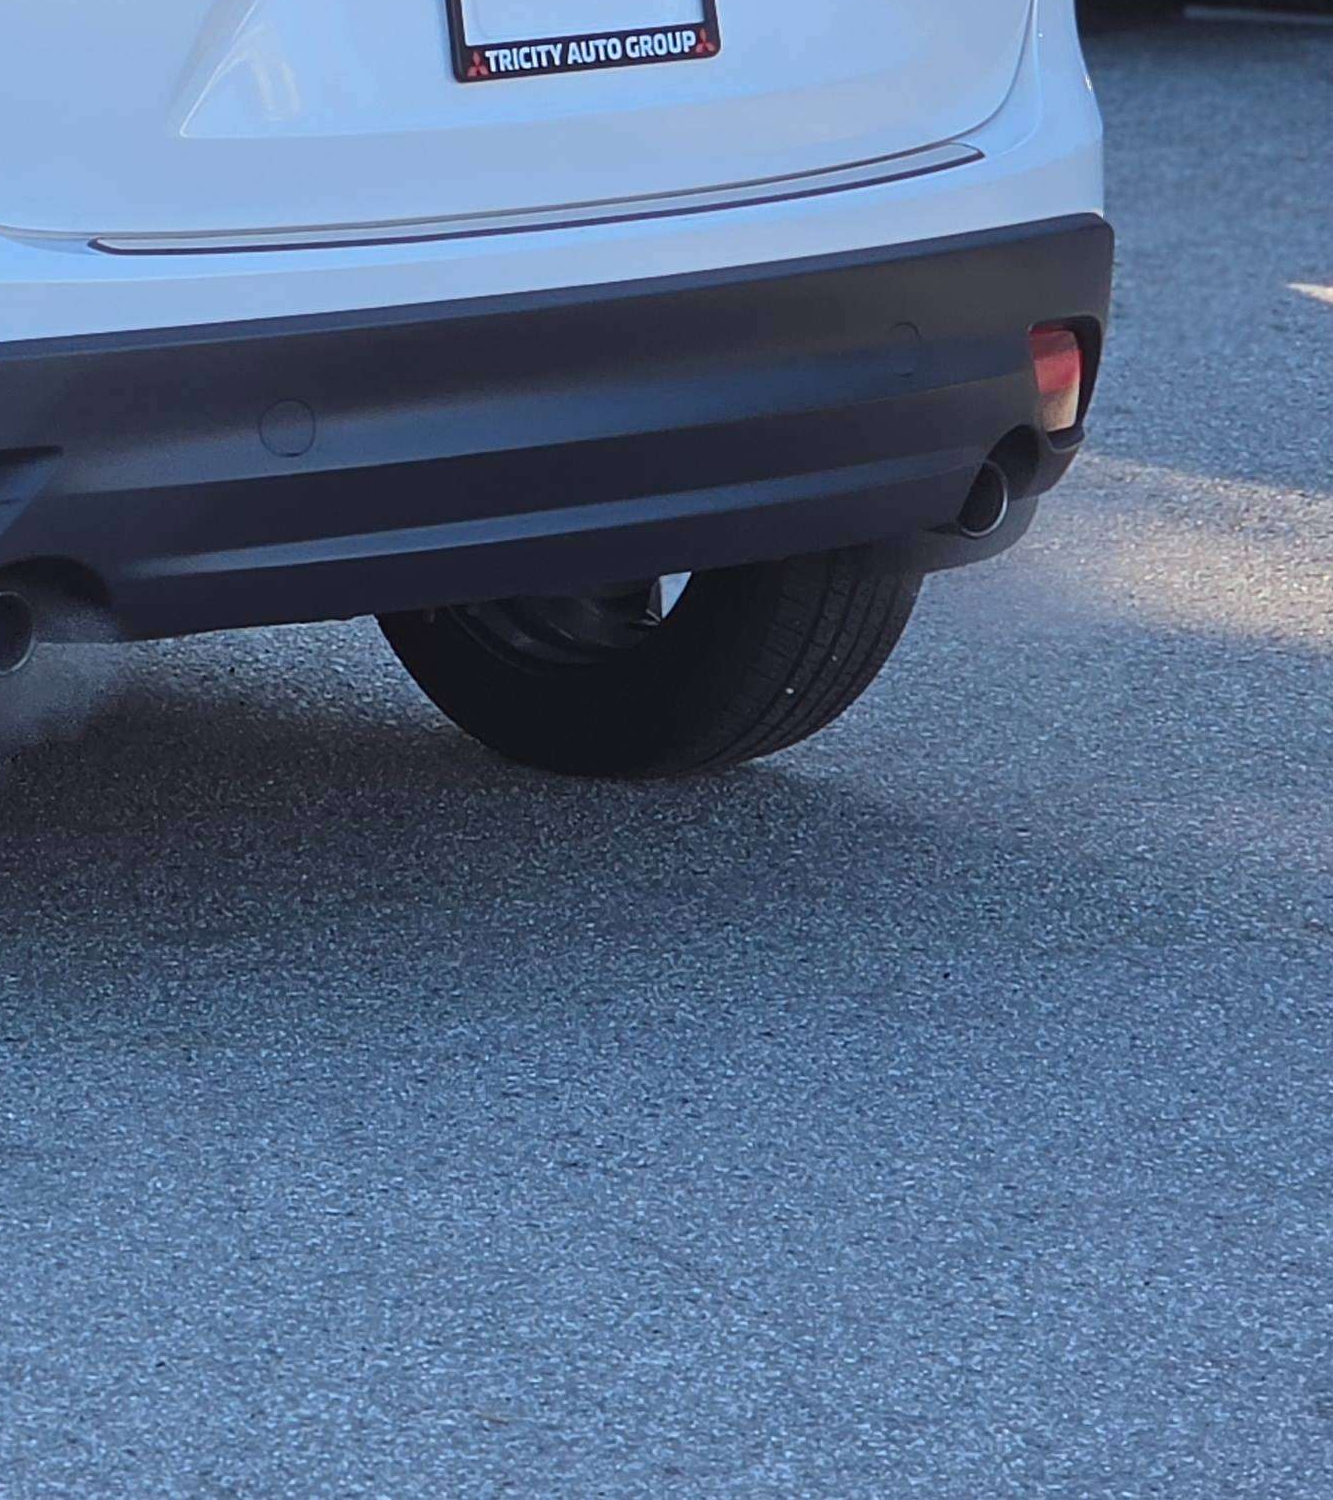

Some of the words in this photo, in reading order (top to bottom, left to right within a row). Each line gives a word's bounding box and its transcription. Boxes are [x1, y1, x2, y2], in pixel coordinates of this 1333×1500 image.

[485, 45, 563, 73] TRICITY
[567, 38, 622, 65] AUTO
[625, 30, 696, 58] GROUP
